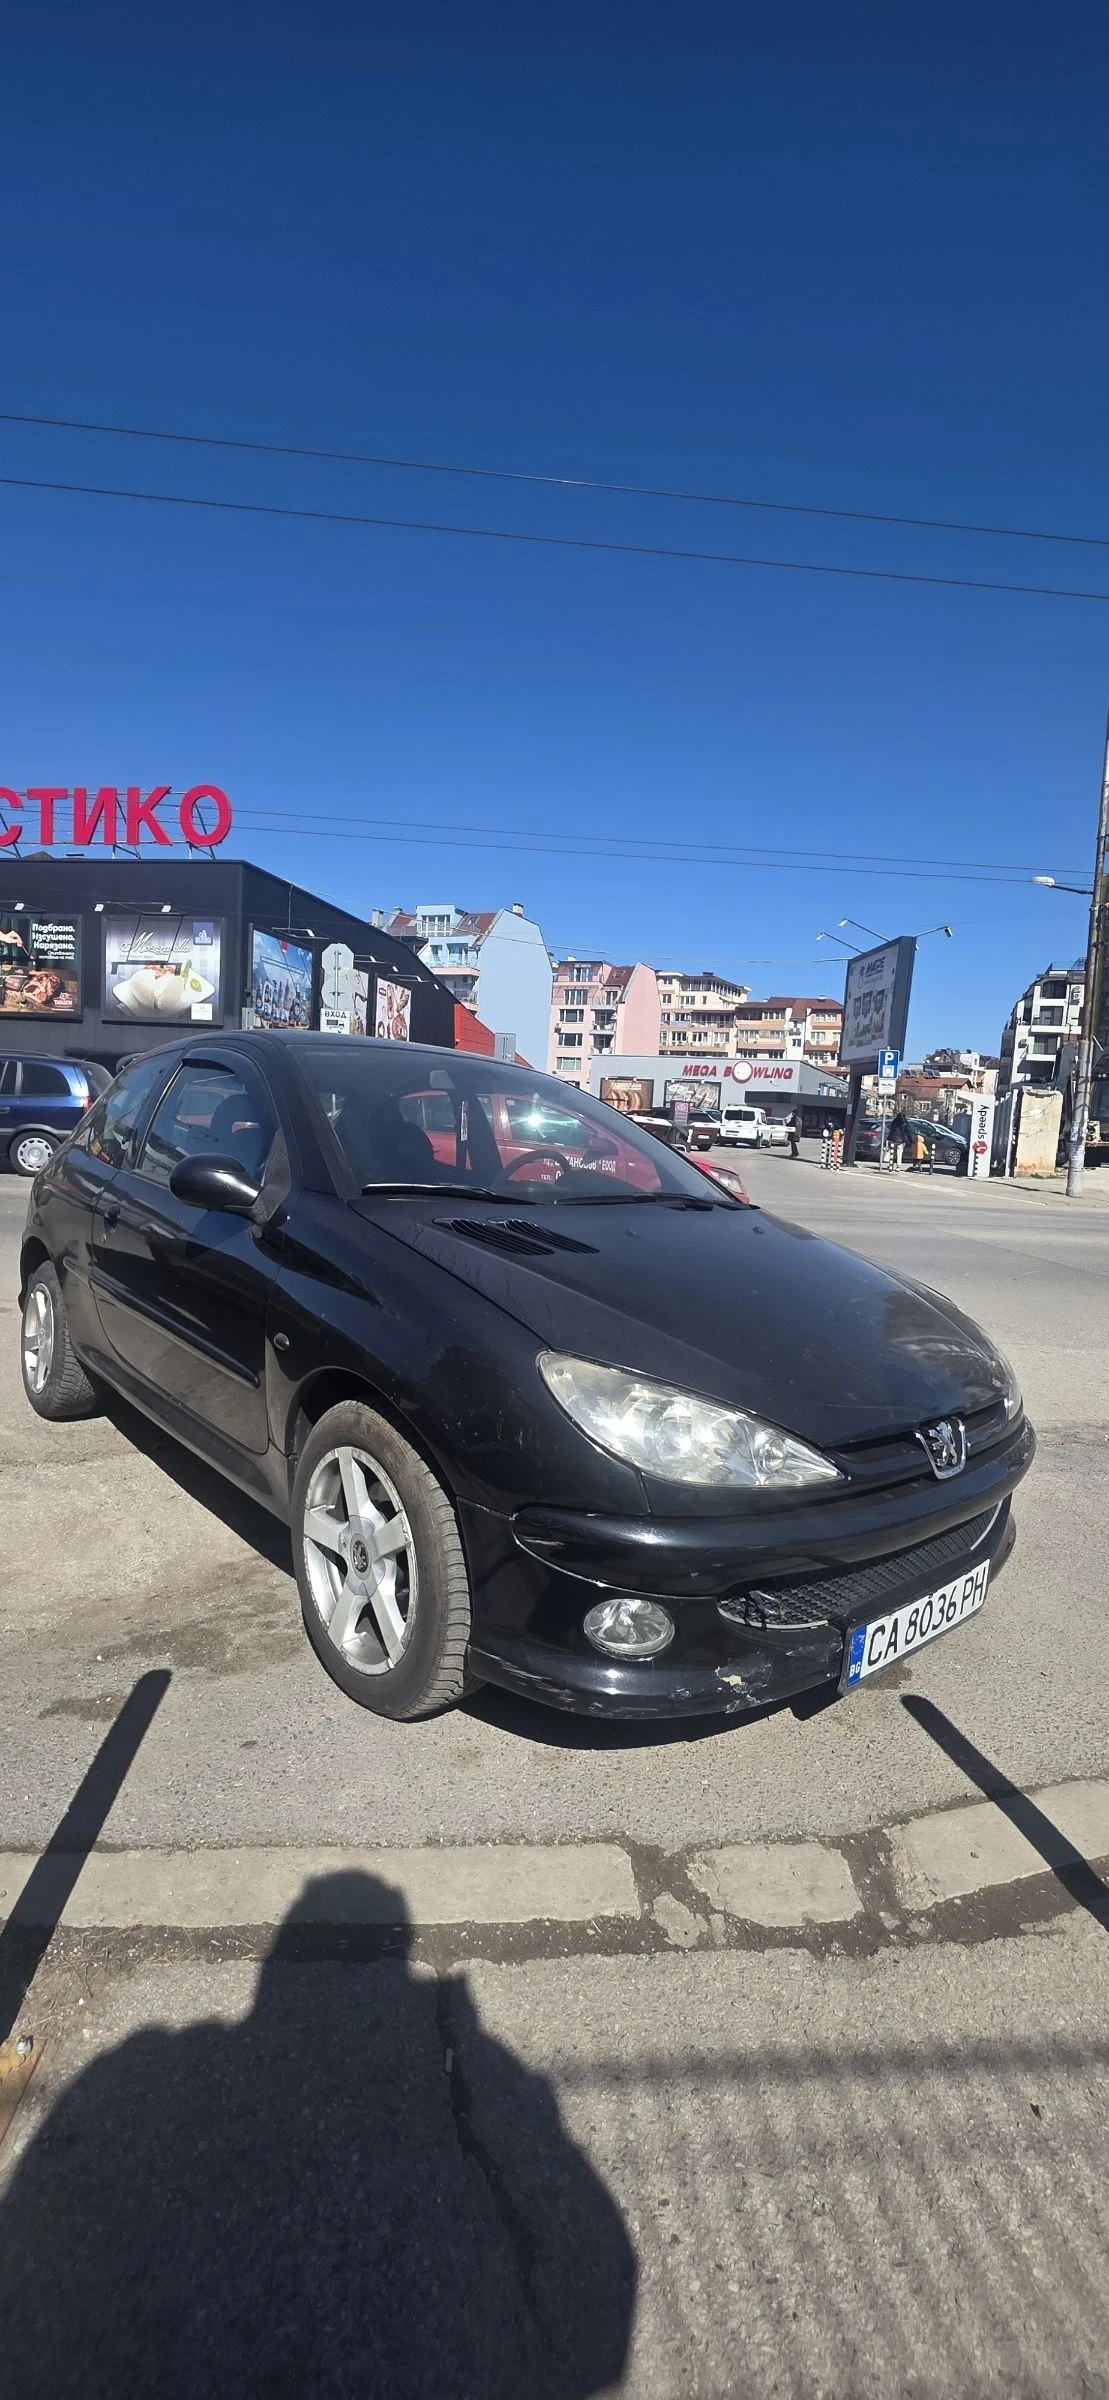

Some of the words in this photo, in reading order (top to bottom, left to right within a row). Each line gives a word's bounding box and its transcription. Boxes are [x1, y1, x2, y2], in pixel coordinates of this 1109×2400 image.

[324, 1010, 347, 1019] ВХОД
[885, 1052, 894, 1065] P
[682, 1064, 717, 1077] MEGA
[723, 1061, 794, 1084] BOWLING
[978, 1104, 990, 1140] speedy
[601, 1160, 617, 1173] ЕООД
[867, 1618, 898, 1667] CA
[905, 1586, 957, 1646] 8036
[960, 1566, 986, 1615] PH
[850, 1661, 861, 1677] BG
